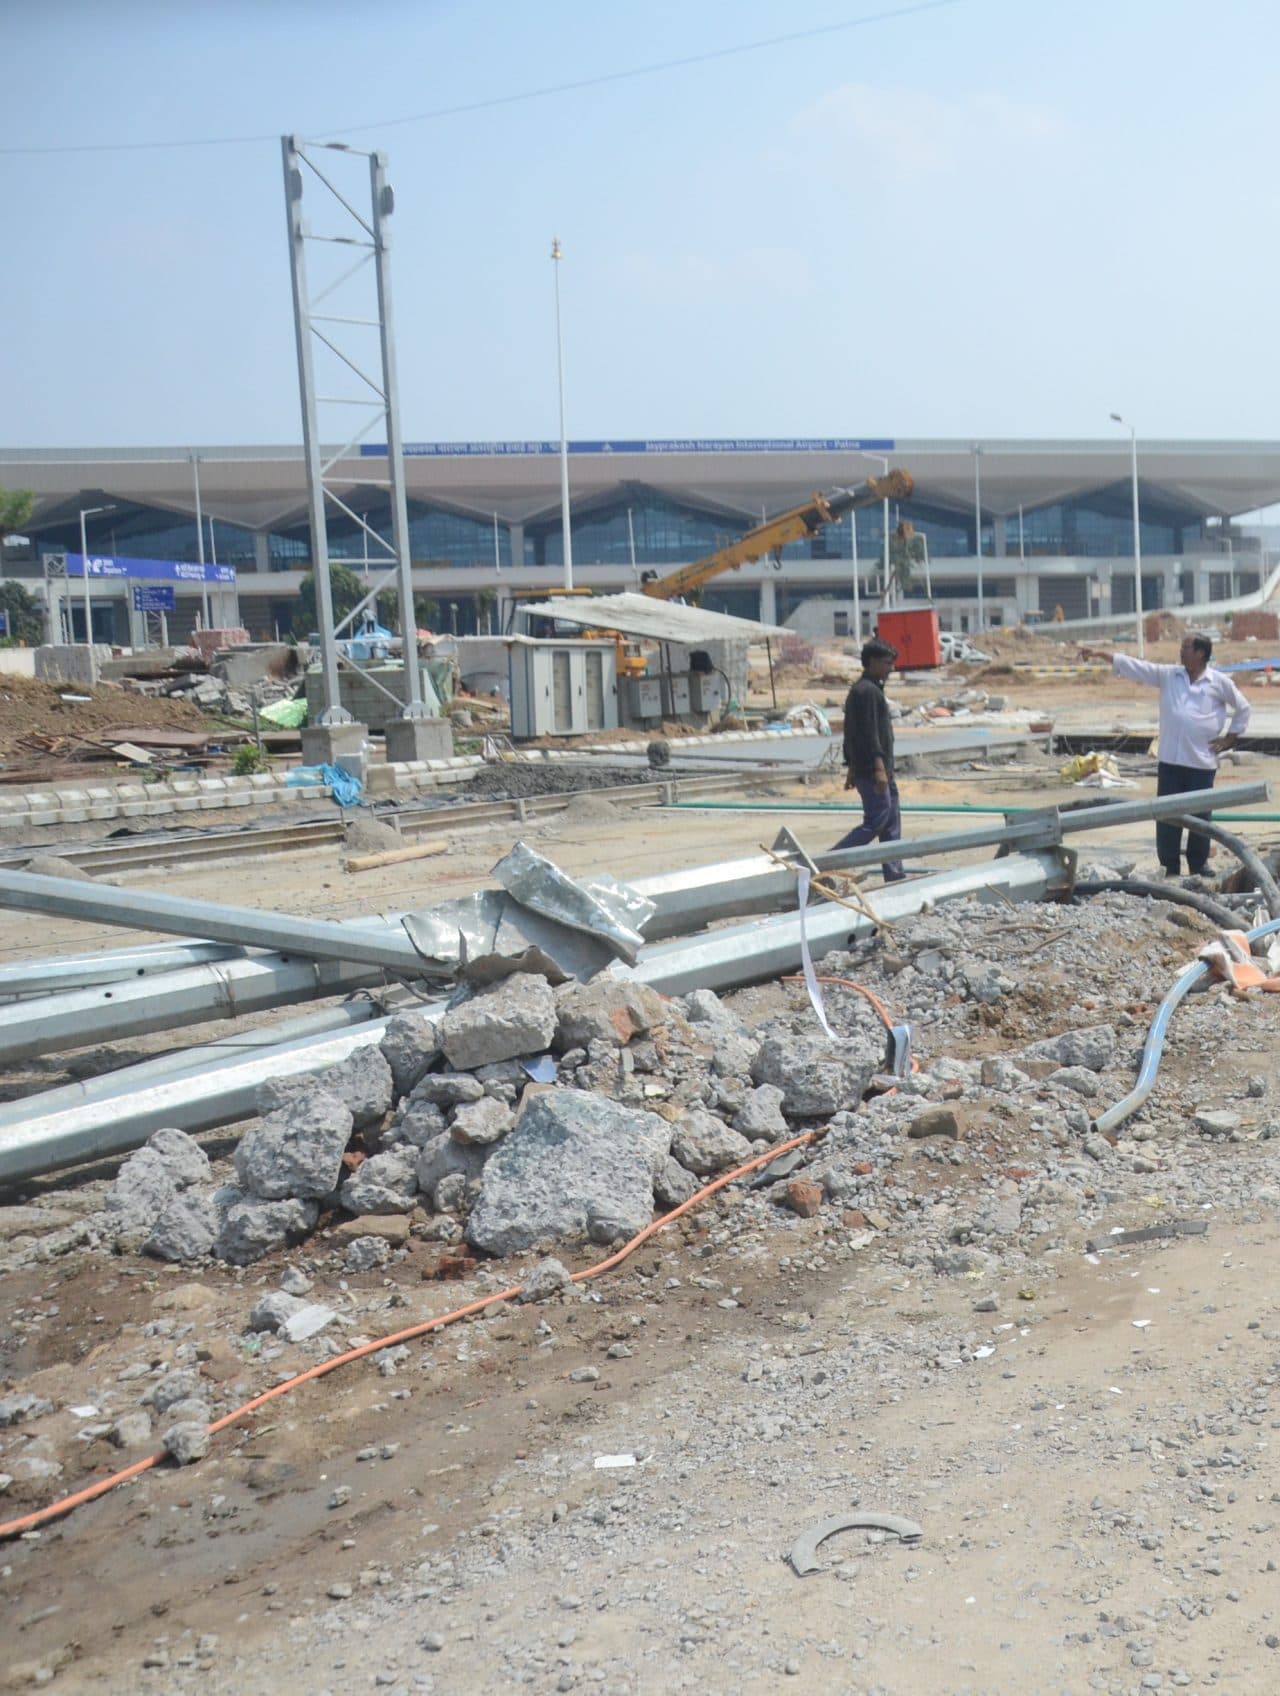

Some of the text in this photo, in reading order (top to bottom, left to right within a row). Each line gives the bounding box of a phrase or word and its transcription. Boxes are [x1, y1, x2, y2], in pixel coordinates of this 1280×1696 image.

[736, 440, 794, 449] International
[797, 440, 827, 450] Airport
[834, 440, 860, 449] Patna
